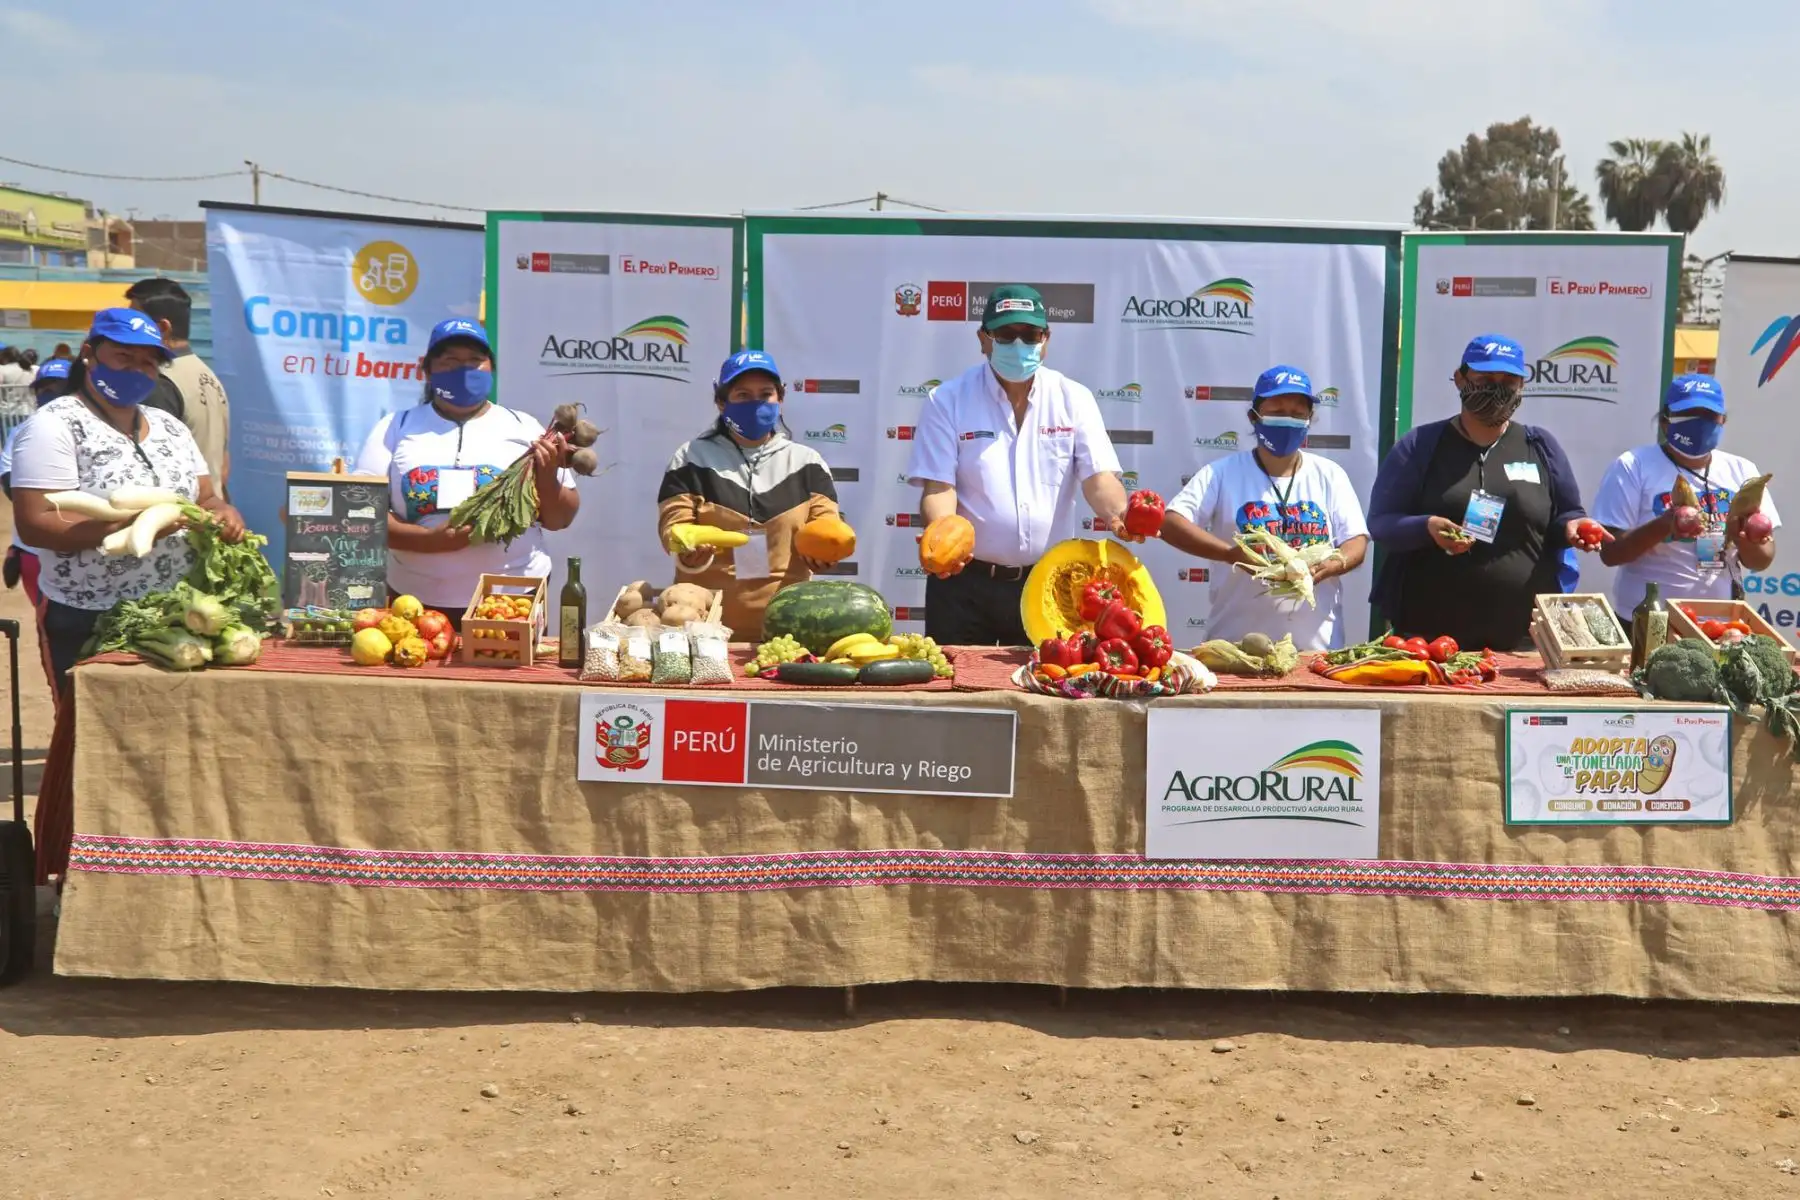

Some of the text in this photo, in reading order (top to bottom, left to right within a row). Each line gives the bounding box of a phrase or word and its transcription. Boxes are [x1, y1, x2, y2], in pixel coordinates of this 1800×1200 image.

[623, 259, 715, 276] EL PERÚ PRIMERO
[1550, 281, 1647, 295] EL PERÚ PRIMERO
[931, 294, 962, 307] PERÚ
[1122, 295, 1254, 319] AGRORURAL
[1049, 308, 1076, 318] Riego
[244, 296, 408, 352] Compra
[541, 334, 691, 364] AGRORURAL
[283, 351, 426, 381] en tu barri
[1523, 359, 1618, 384] ORURAL
[266, 437, 279, 448] TU
[299, 453, 313, 464] TU
[320, 535, 360, 553] Vive
[1744, 569, 1800, 596] ásQ
[672, 726, 736, 753] PERÚ
[758, 733, 859, 755] Ministerio
[1570, 737, 1648, 755] ADOPTA
[757, 753, 972, 783] de Agricultura y Riego
[1564, 767, 1573, 775] DE
[1573, 755, 1642, 770] TONELADA
[1163, 770, 1363, 801] AGRORURAL
[1575, 771, 1637, 791] PAPA
[1214, 805, 1261, 813] DESARROLLO
[1262, 805, 1307, 813] PRODUCTIVO
